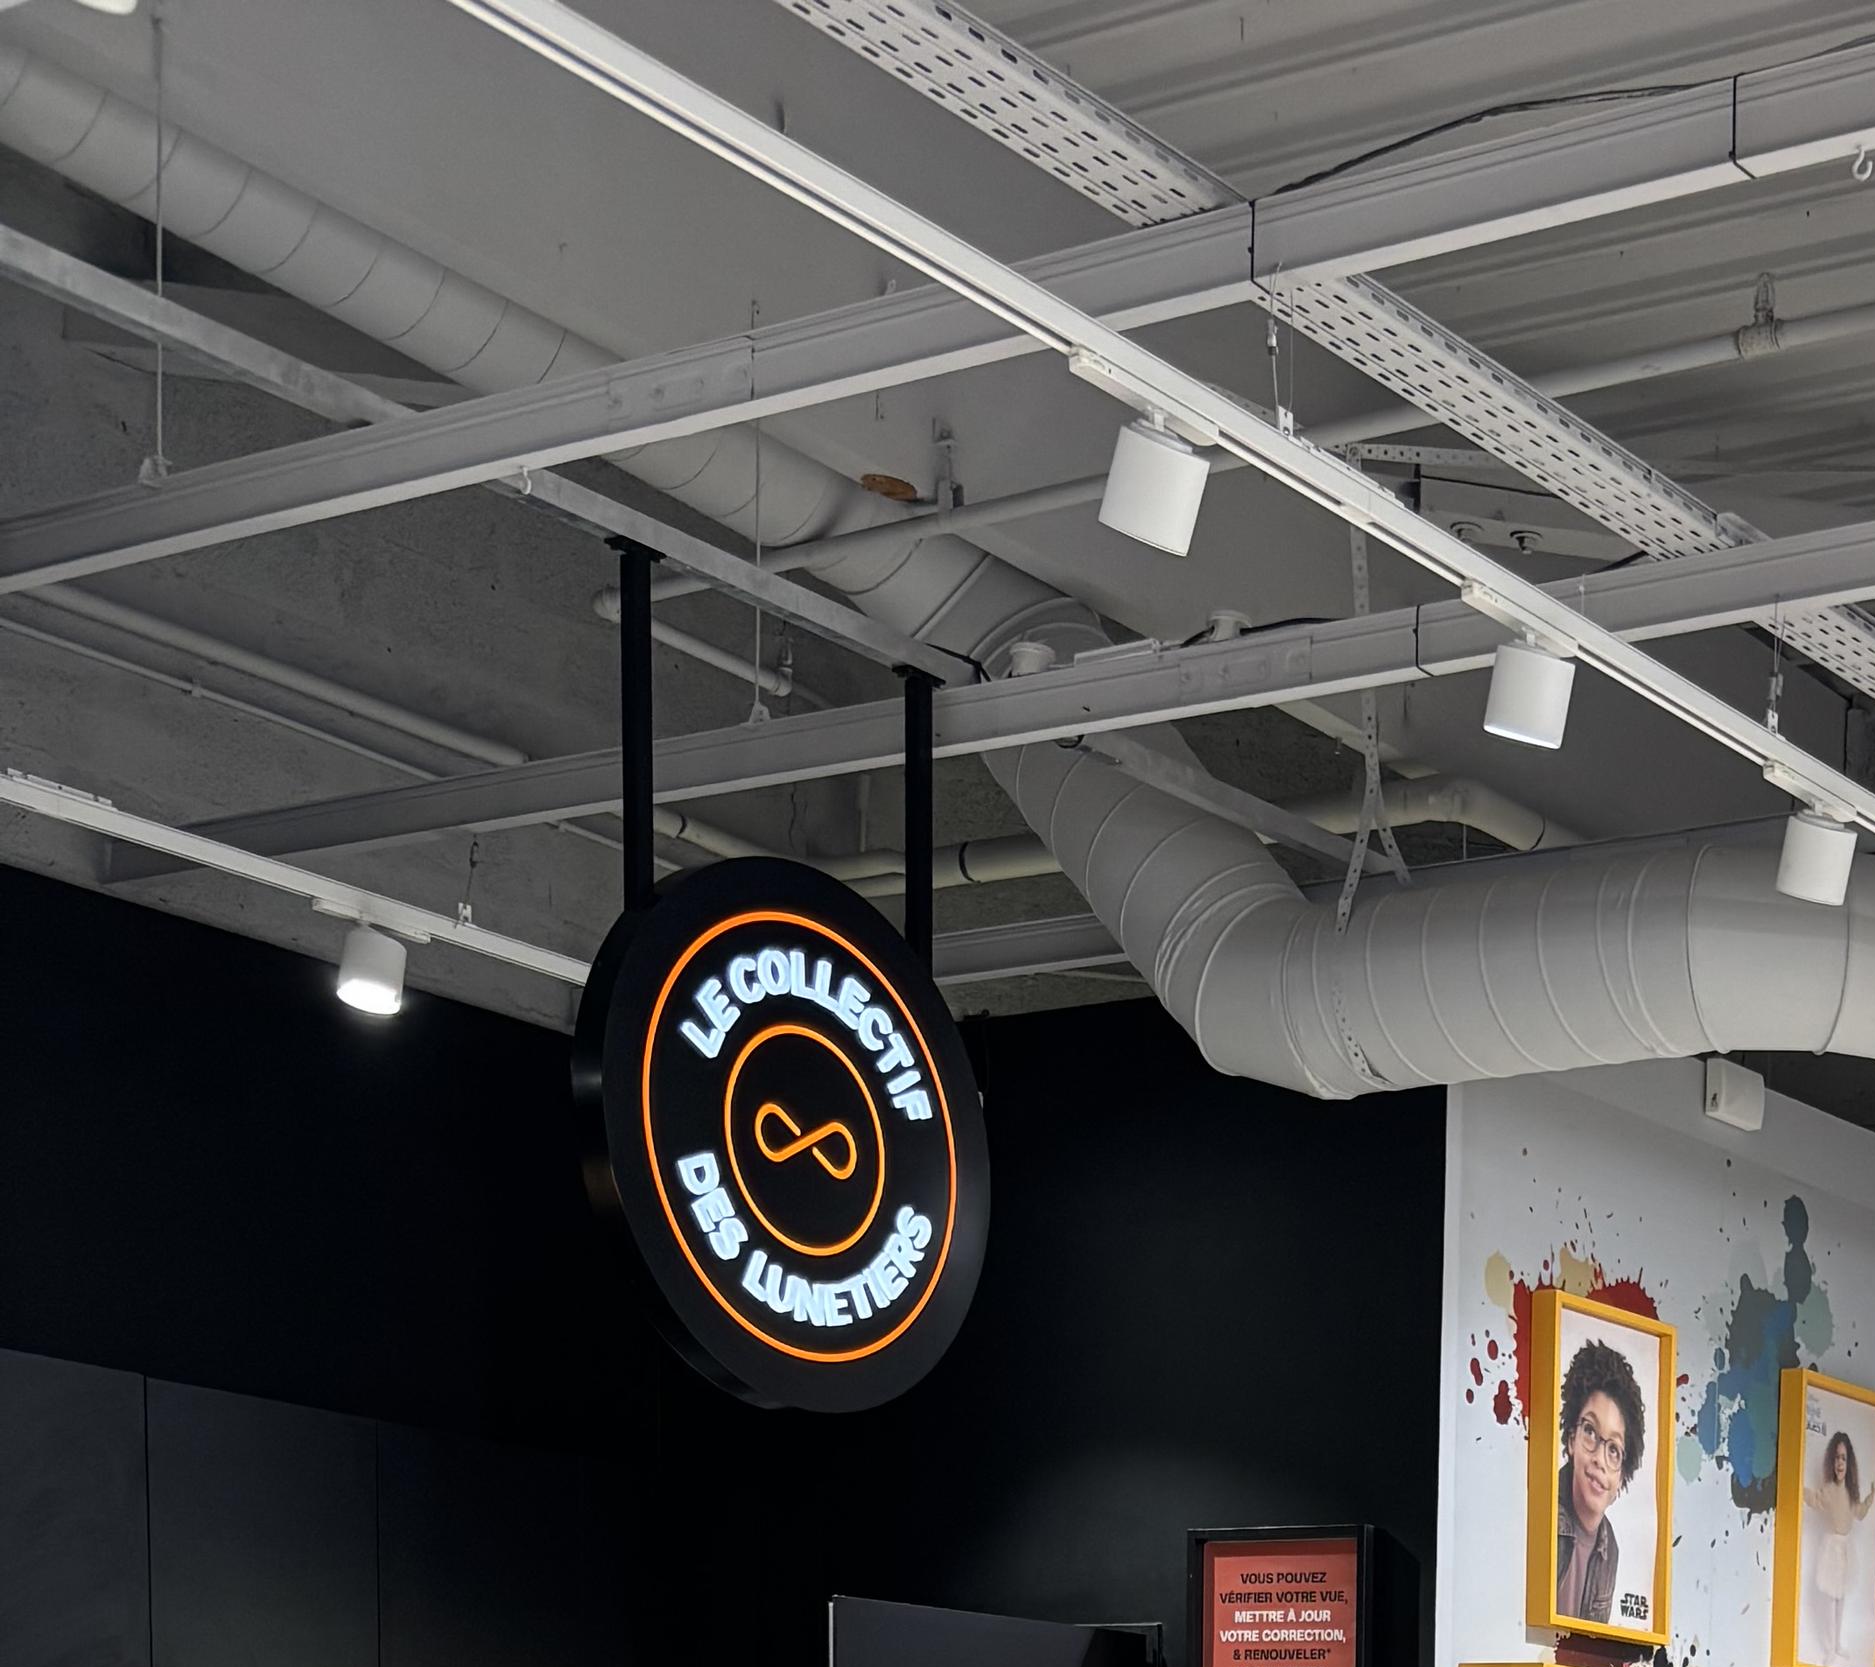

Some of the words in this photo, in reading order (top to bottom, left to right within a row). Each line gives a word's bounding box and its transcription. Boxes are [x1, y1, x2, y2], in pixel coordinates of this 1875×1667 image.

[678, 977, 742, 1059] LE
[728, 947, 934, 1122] COLLECTIF
[676, 1152, 749, 1261] DES
[741, 1205, 932, 1327] LUNETIERS
[1241, 1572, 1274, 1584] VOUS
[1277, 1572, 1327, 1584] POUVEZ
[1220, 1590, 1272, 1604] VÉRIFIER
[1276, 1591, 1316, 1603] VOTRE
[1320, 1591, 1348, 1604] VUE,
[1620, 1593, 1648, 1608] STAR
[1234, 1610, 1285, 1623] METTRE
[1287, 1608, 1296, 1622] À
[1299, 1610, 1331, 1622] JOUR
[1620, 1605, 1648, 1620] WARS
[1220, 1630, 1260, 1642] VOTRE
[1262, 1629, 1346, 1644] CORRECTION,
[1233, 1650, 1241, 1660] &
